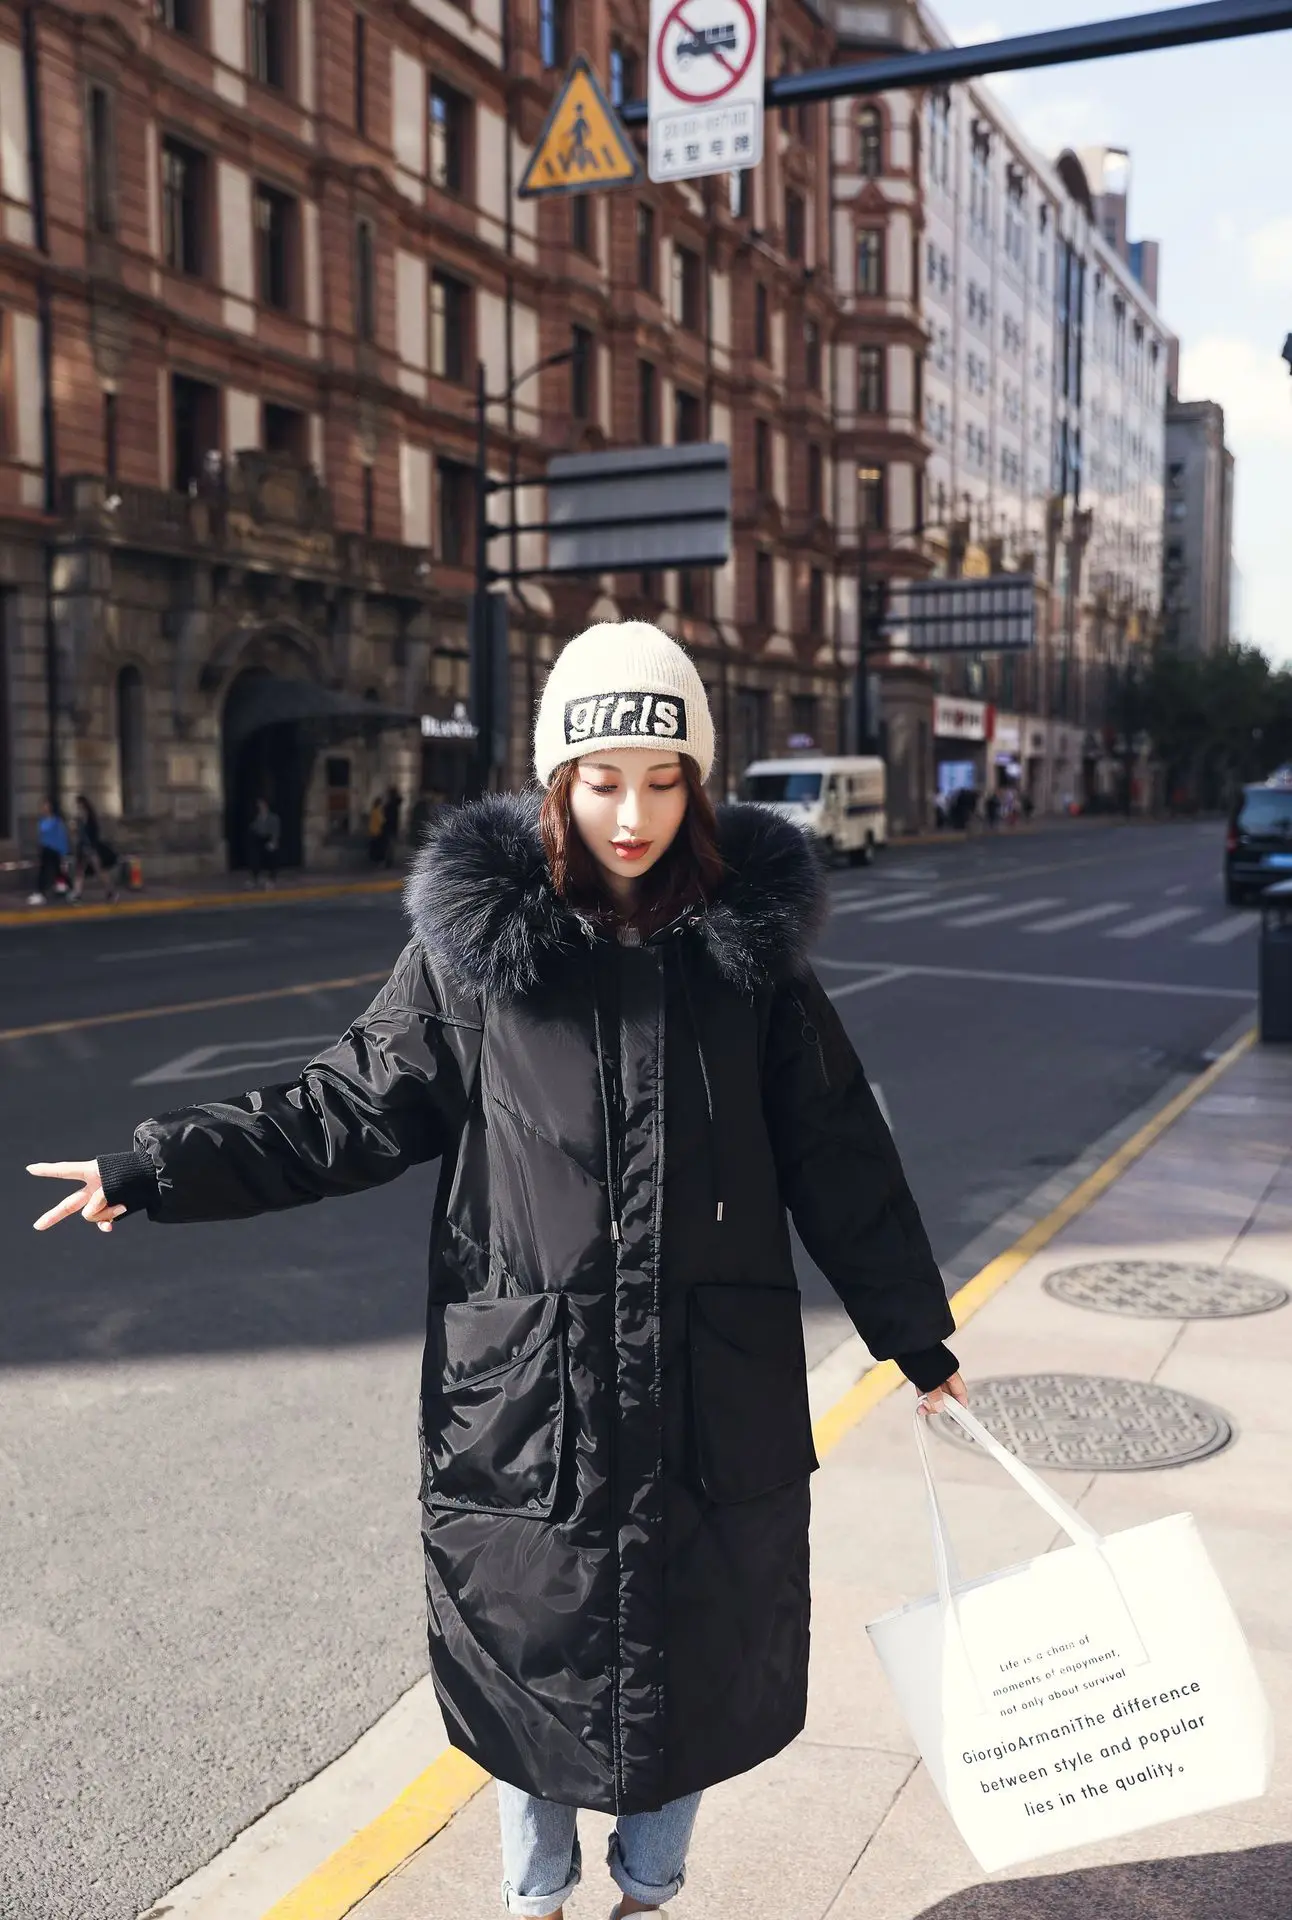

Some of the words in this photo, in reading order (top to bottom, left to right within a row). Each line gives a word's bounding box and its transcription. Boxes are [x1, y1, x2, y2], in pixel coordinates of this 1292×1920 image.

[569, 696, 679, 742] girls
[1000, 1660, 1020, 1672] Life
[1024, 1656, 1032, 1665] is
[1036, 1651, 1043, 1660] a
[1047, 1641, 1076, 1656] chain
[1080, 1634, 1090, 1645] of
[992, 1675, 1042, 1696] moments
[1046, 1669, 1056, 1679] of
[1000, 1704, 1017, 1717] not
[1022, 1697, 1044, 1710] only
[1048, 1684, 1080, 1701] about
[1083, 1668, 1126, 1690] survival
[1112, 1680, 1201, 1720] difference
[980, 1767, 1048, 1794] between
[1054, 1752, 1094, 1773] style
[1100, 1738, 1132, 1758] and
[1138, 1714, 1206, 1748] popular
[1024, 1796, 1054, 1816] lies
[1060, 1792, 1076, 1806] in
[1082, 1781, 1109, 1798] the
